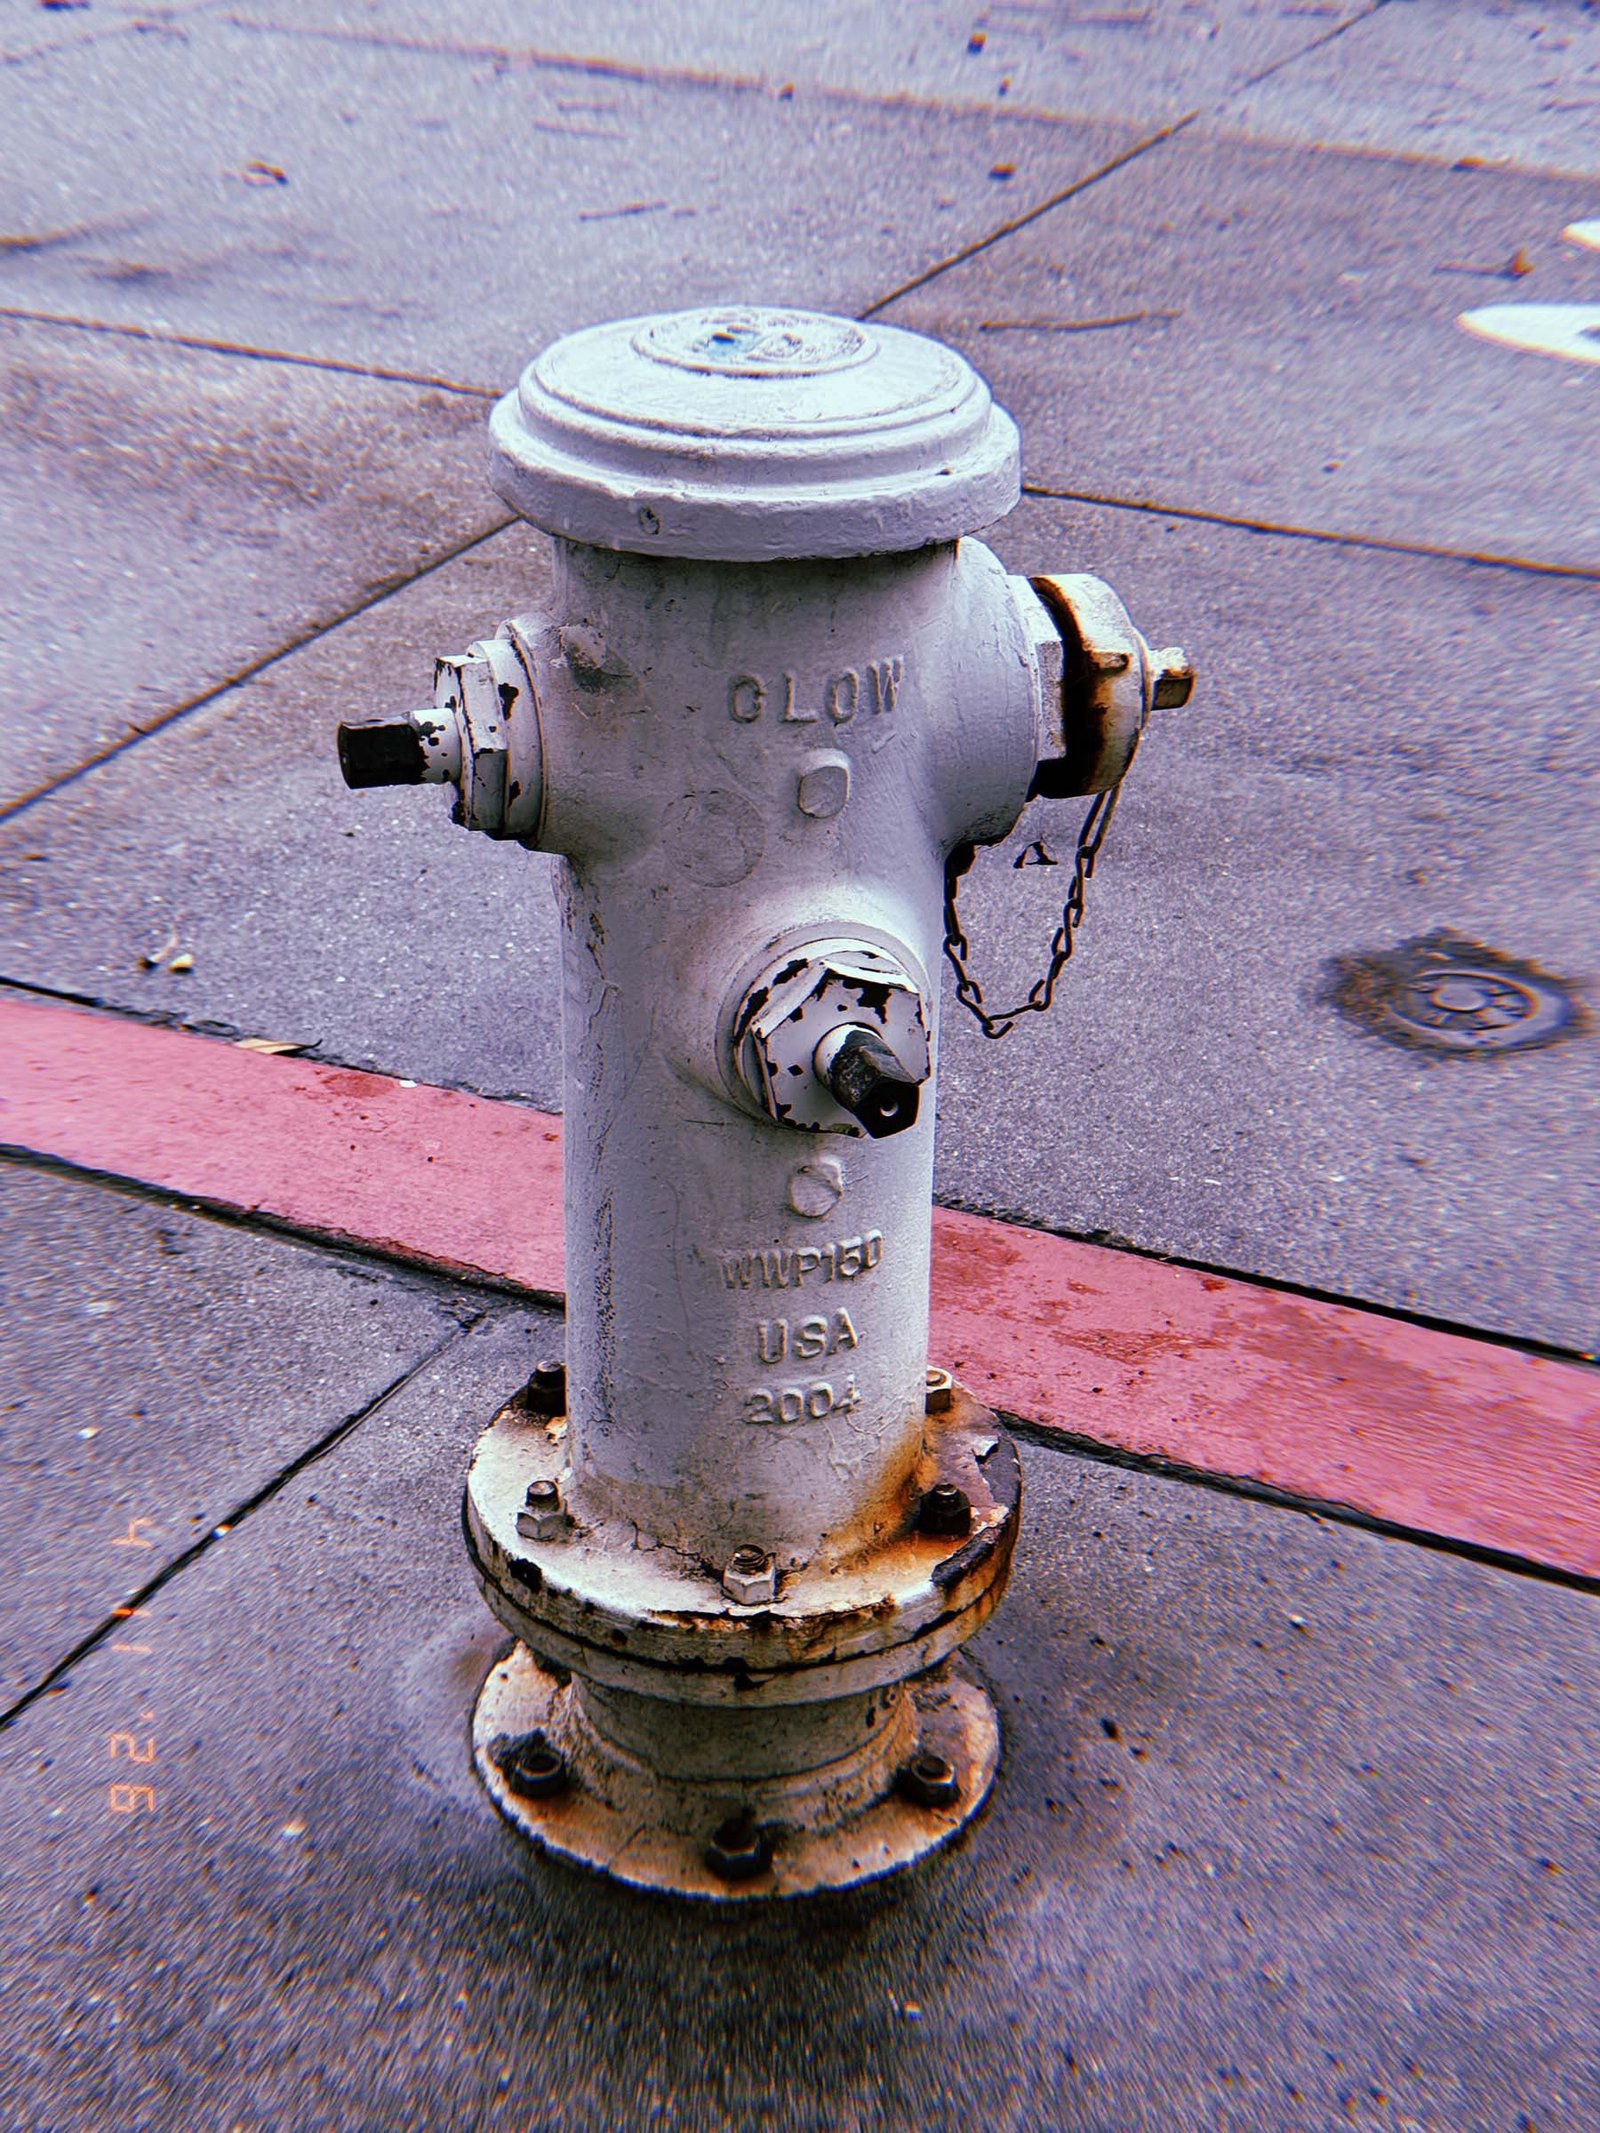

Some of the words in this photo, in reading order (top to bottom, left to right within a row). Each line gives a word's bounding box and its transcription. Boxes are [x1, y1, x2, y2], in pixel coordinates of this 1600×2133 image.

[728, 655, 905, 724] CLOW
[717, 1229, 883, 1289] WWP150
[758, 1306, 858, 1364] USA
[741, 1373, 862, 1424] 2004
